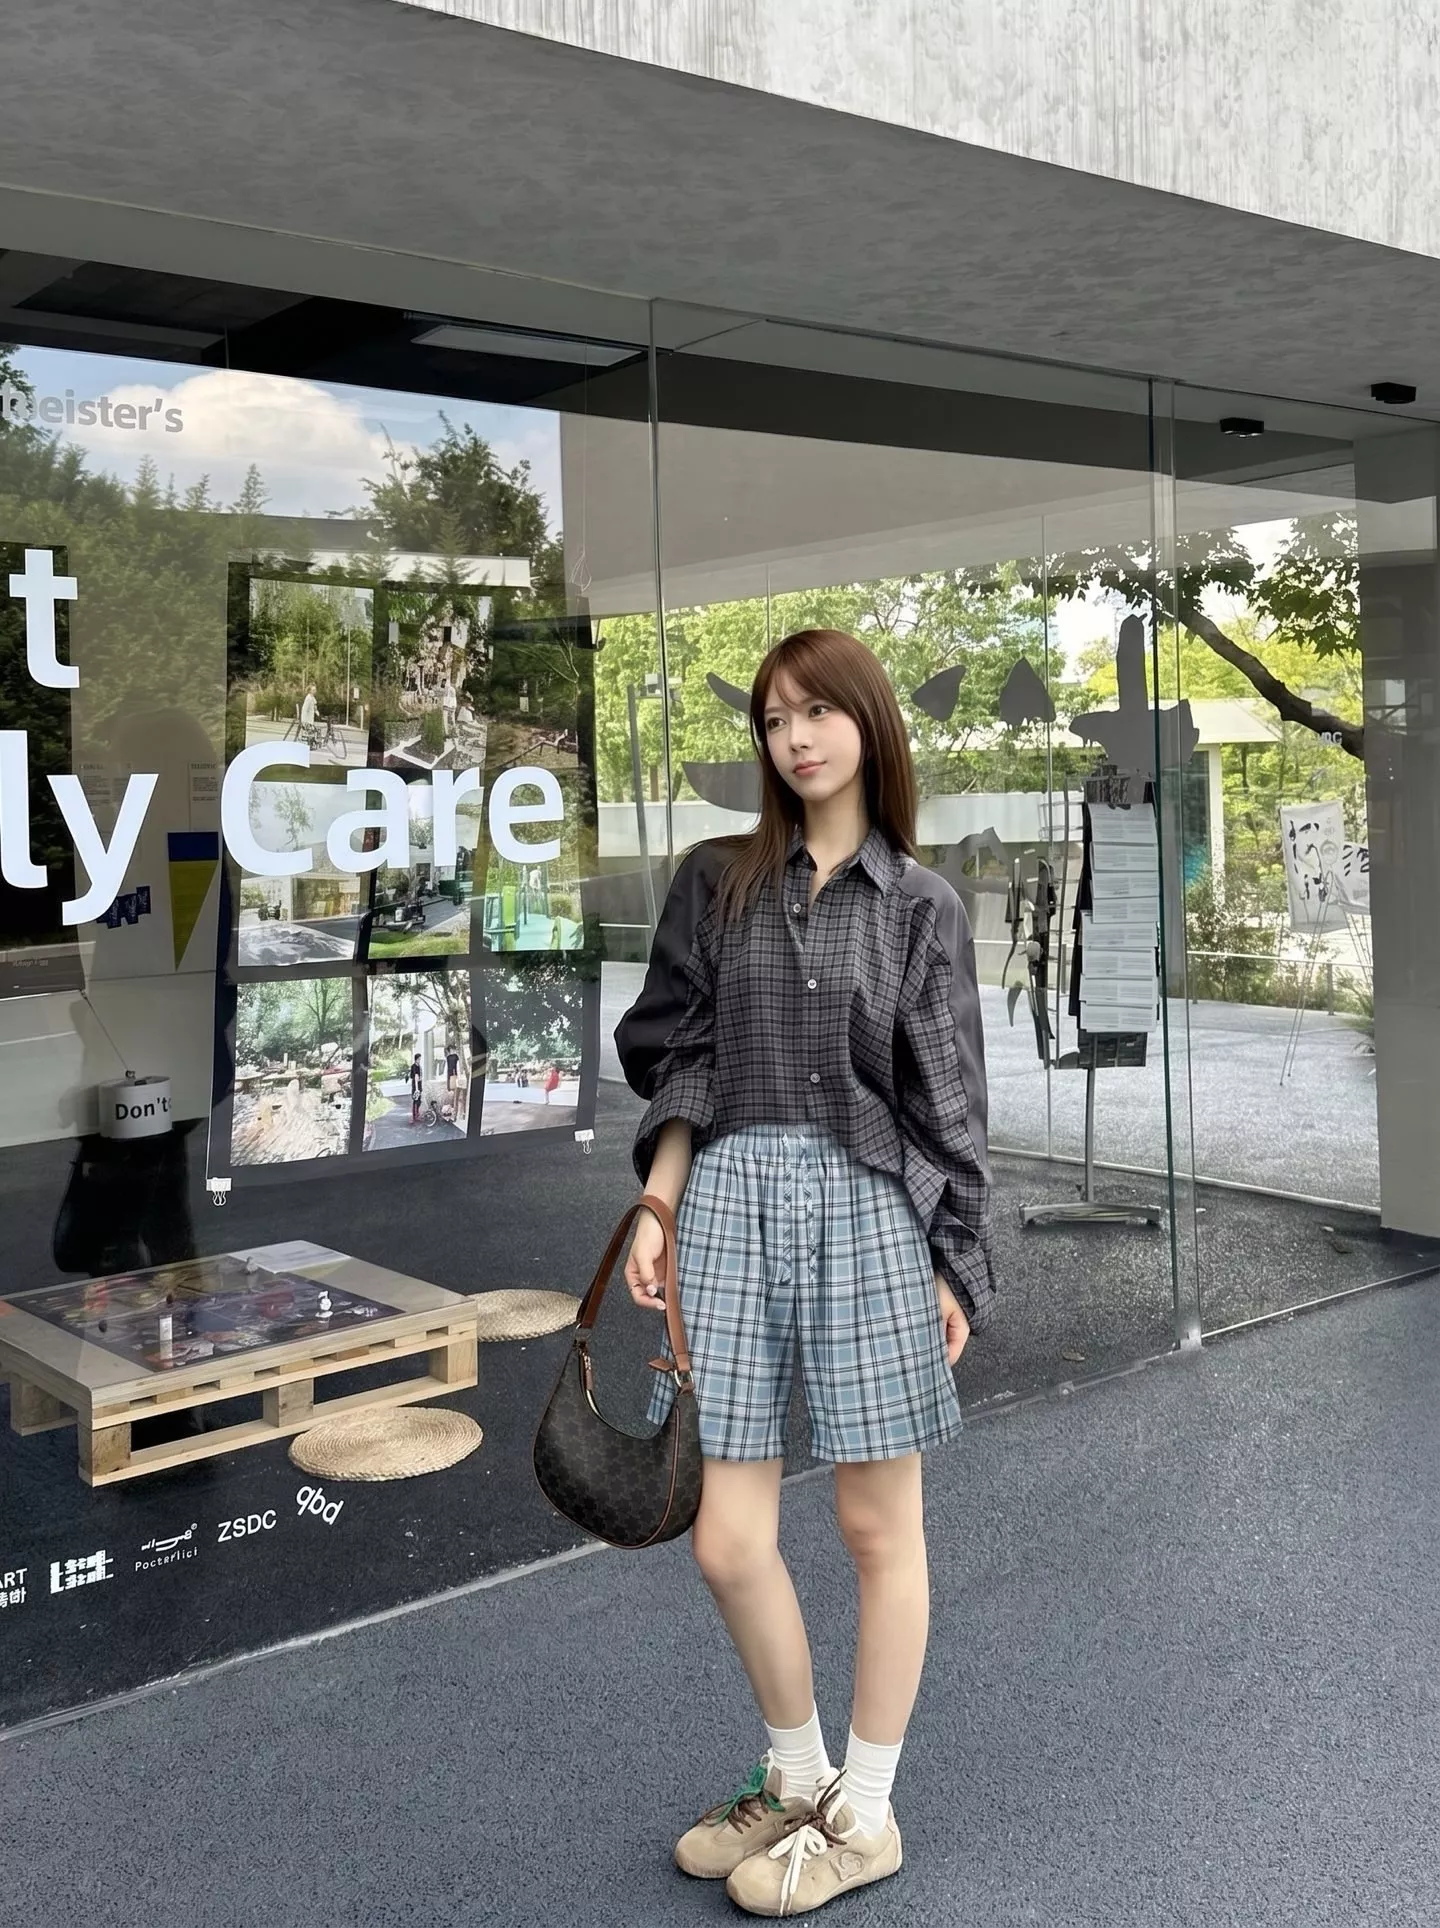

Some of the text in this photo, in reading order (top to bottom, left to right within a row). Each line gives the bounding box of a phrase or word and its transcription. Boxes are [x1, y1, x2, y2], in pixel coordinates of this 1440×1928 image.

[9, 549, 80, 689] t
[0, 730, 565, 926] ly Care
[115, 1097, 168, 1121] Don't
[217, 1509, 277, 1543] ZSDC
